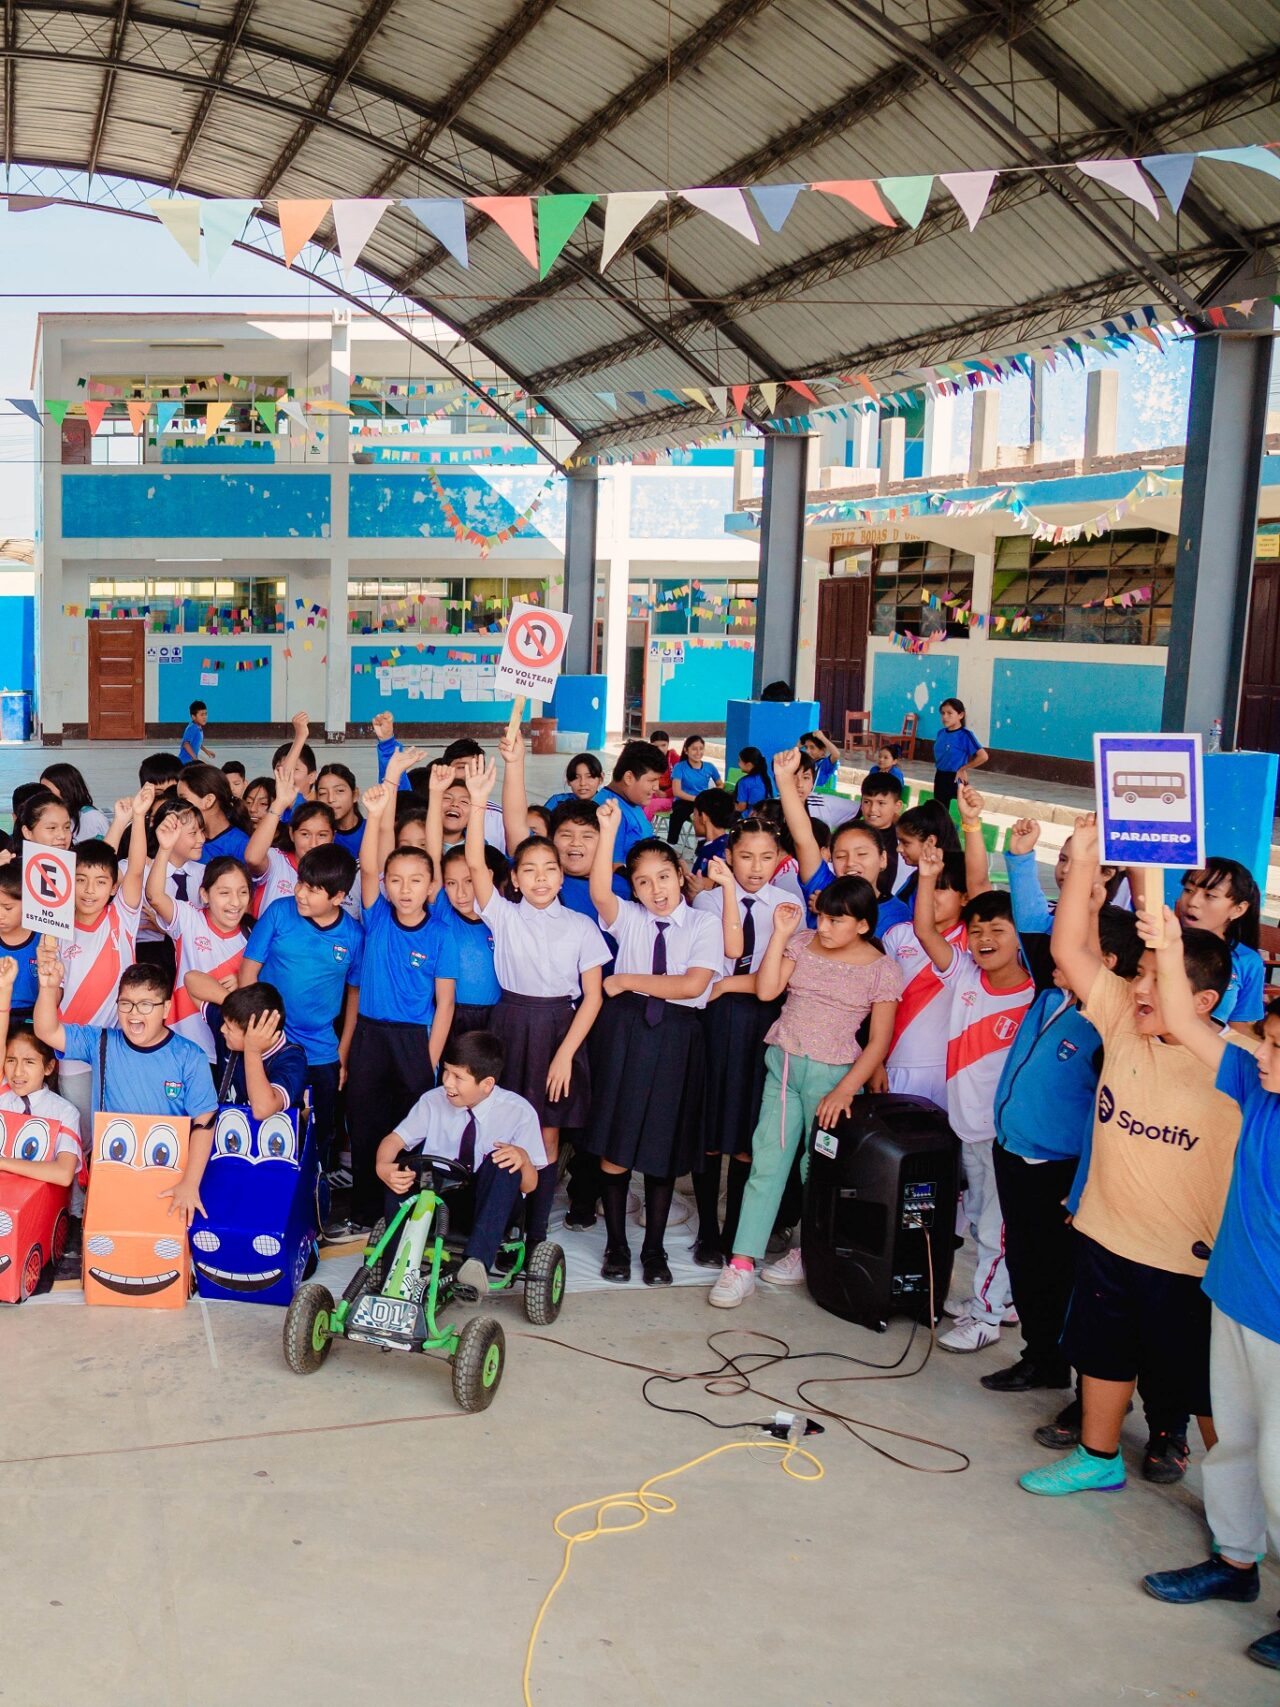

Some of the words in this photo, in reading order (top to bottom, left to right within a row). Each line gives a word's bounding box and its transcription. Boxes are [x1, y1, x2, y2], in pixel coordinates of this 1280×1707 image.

[831, 531, 856, 545] FELIZ
[861, 528, 888, 544] BODAS
[500, 666, 514, 674] NO
[515, 669, 554, 684] VOLTEAR
[515, 678, 527, 686] EN
[1110, 831, 1191, 843] PARADERO
[25, 913, 70, 930] ESTACIONAR
[41, 909, 54, 918] NO
[1116, 1110, 1200, 1151] Spotify
[372, 1302, 404, 1327] 01
